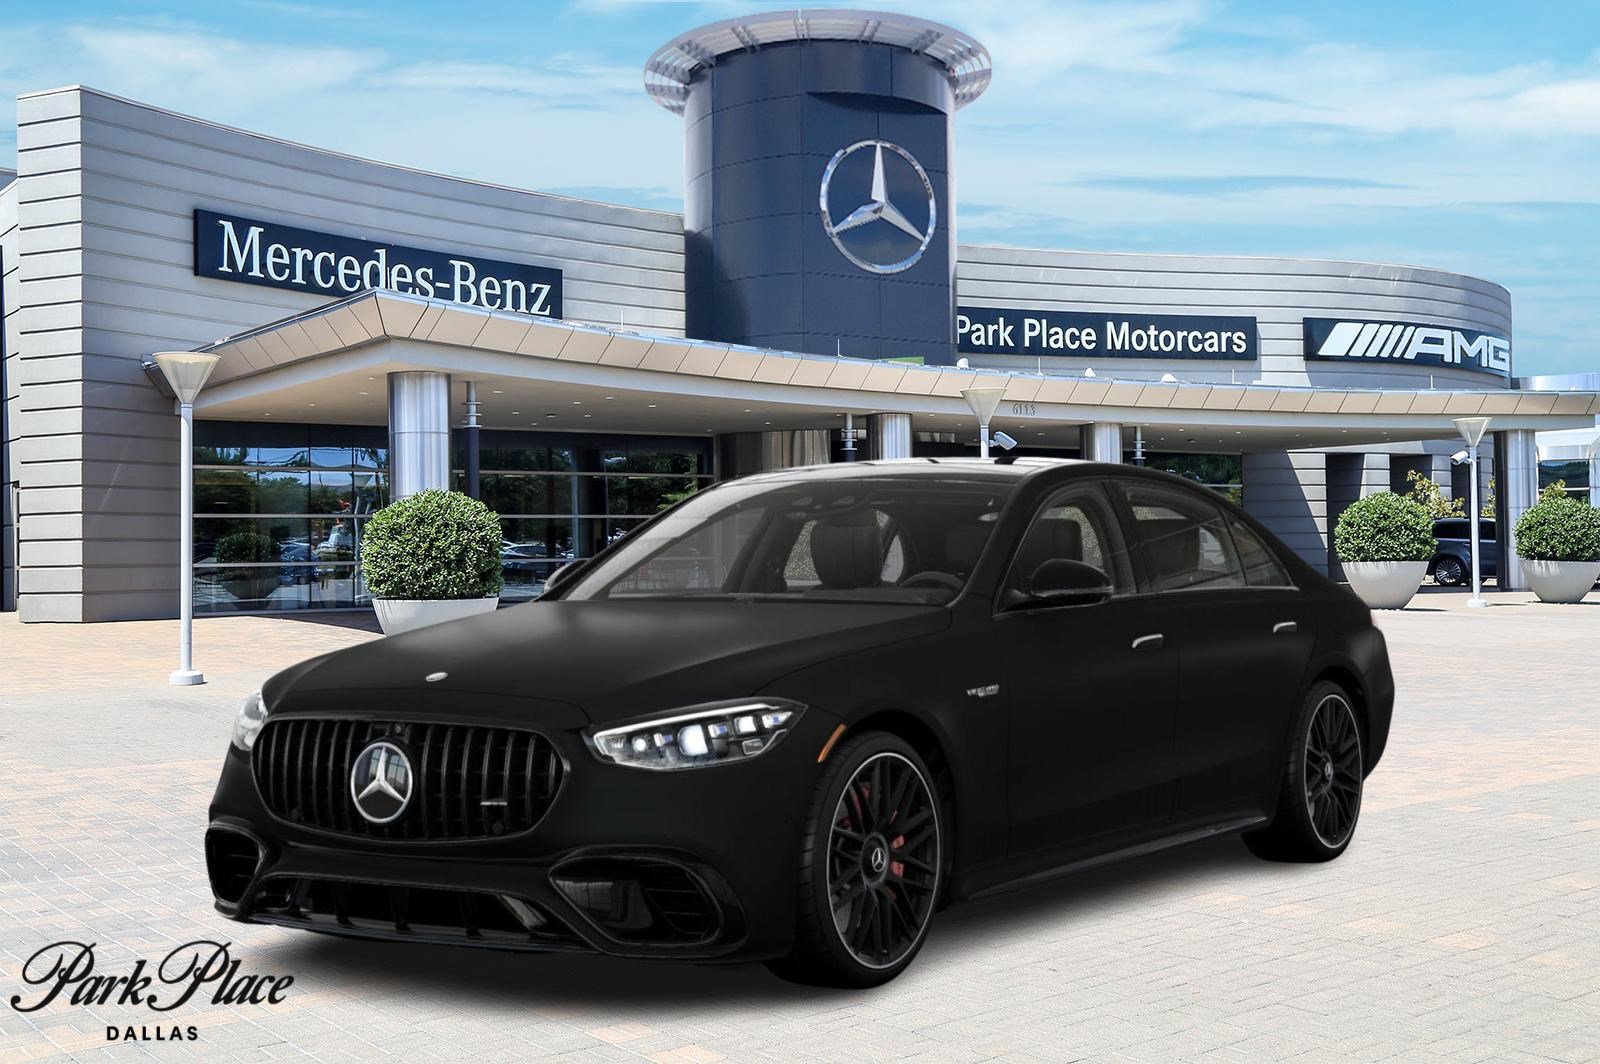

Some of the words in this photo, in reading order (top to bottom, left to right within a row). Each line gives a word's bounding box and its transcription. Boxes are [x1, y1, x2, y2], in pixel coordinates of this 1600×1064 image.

[218, 219, 552, 316] Mercedes-Benz
[957, 315, 1015, 347] Park
[1024, 318, 1097, 350] Place
[1106, 321, 1247, 353] Motorcars
[1012, 402, 1036, 416] 6113
